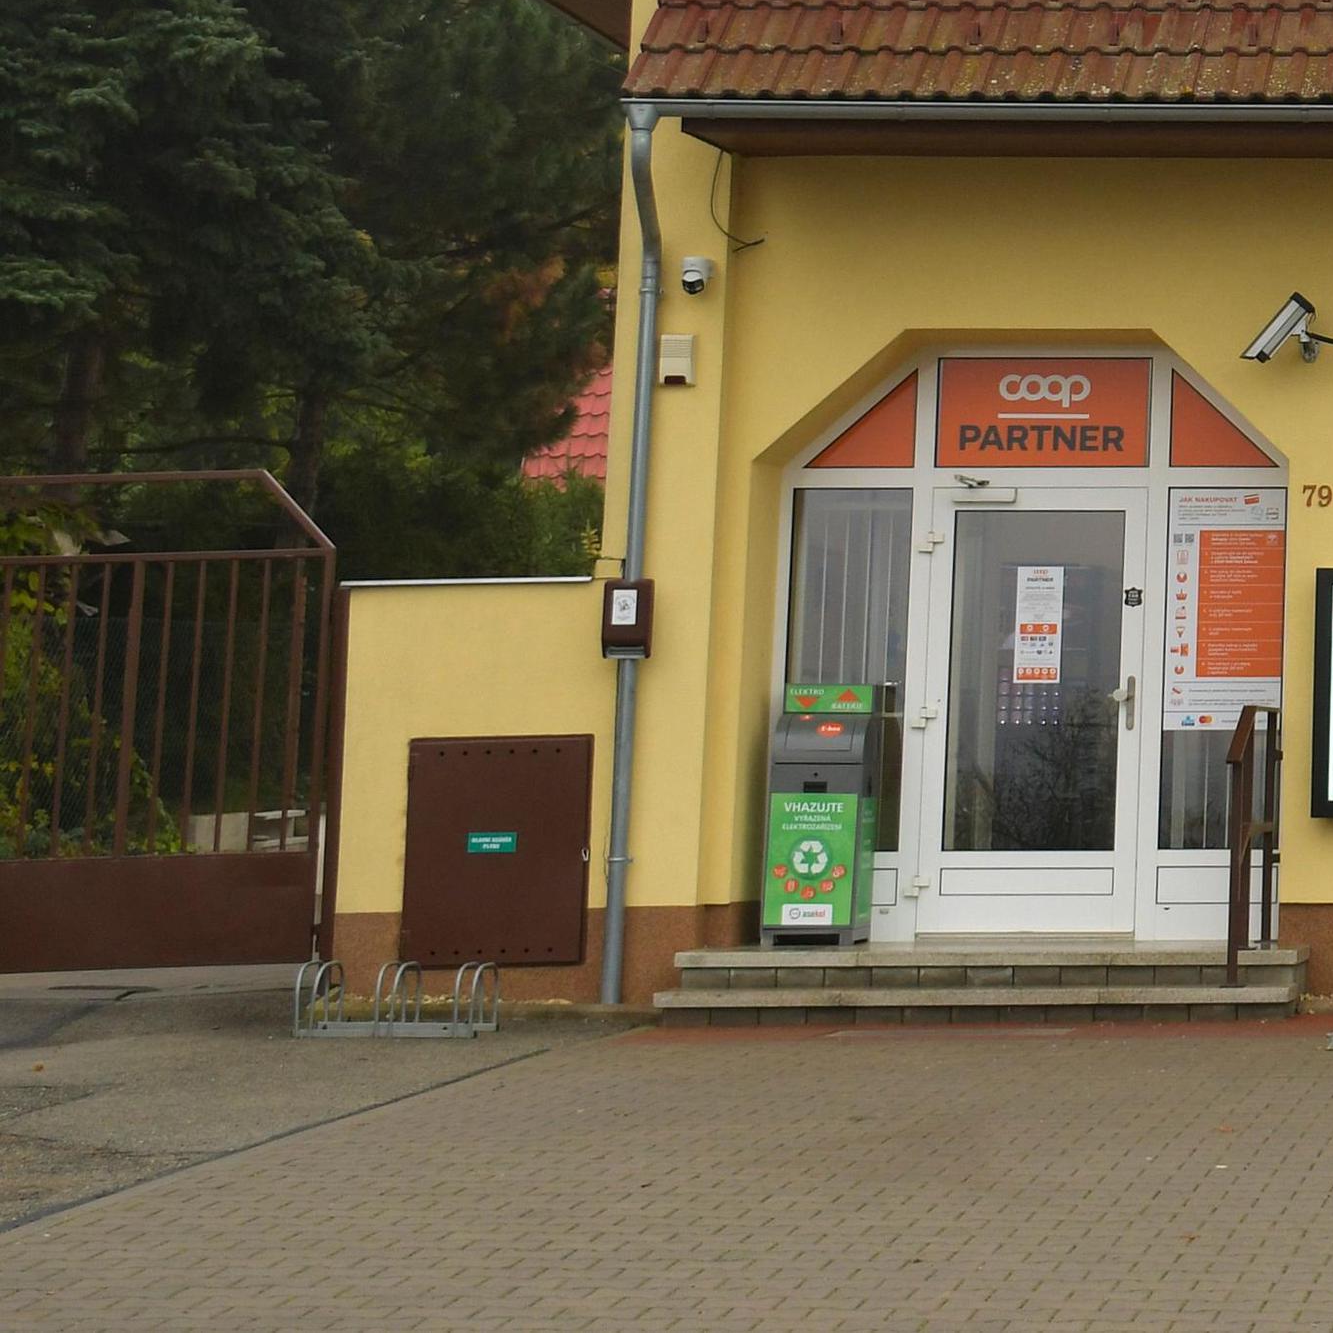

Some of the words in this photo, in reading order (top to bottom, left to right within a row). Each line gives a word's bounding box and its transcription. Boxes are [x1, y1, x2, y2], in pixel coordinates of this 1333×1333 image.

[999, 374, 1091, 407] coop
[959, 425, 1124, 451] PARTNER
[1302, 484, 1333, 508] 79
[790, 688, 825, 696] ELEKTRO
[784, 802, 844, 813] VHAZUJTE
